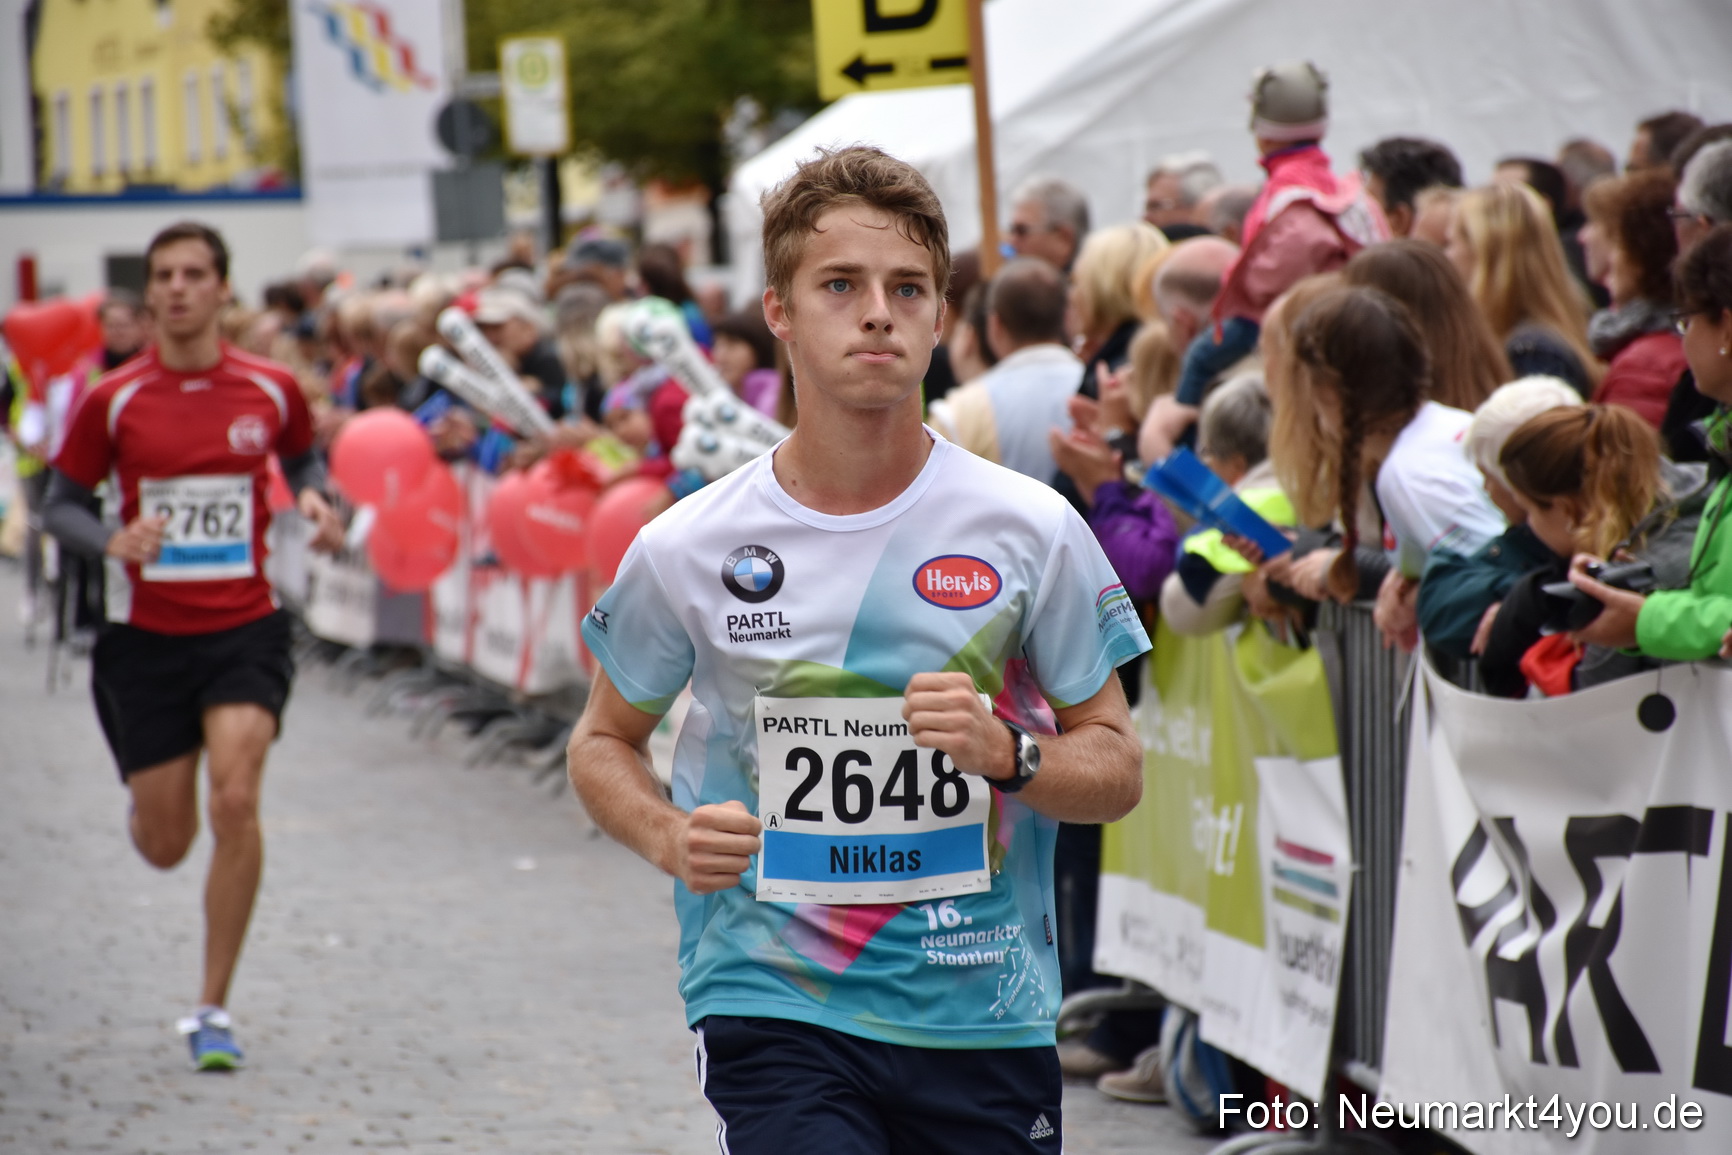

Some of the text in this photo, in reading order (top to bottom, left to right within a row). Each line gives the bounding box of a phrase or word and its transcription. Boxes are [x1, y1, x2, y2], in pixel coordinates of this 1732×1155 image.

[725, 546, 780, 567] BMW
[926, 569, 992, 595] Hervis
[727, 611, 790, 631] PARTL
[729, 628, 792, 643] Neumarkt
[762, 716, 837, 737] PARTL
[784, 746, 970, 825] 2648
[769, 815, 778, 828] A
[830, 844, 922, 874] Niklas
[918, 899, 973, 931] 16.
